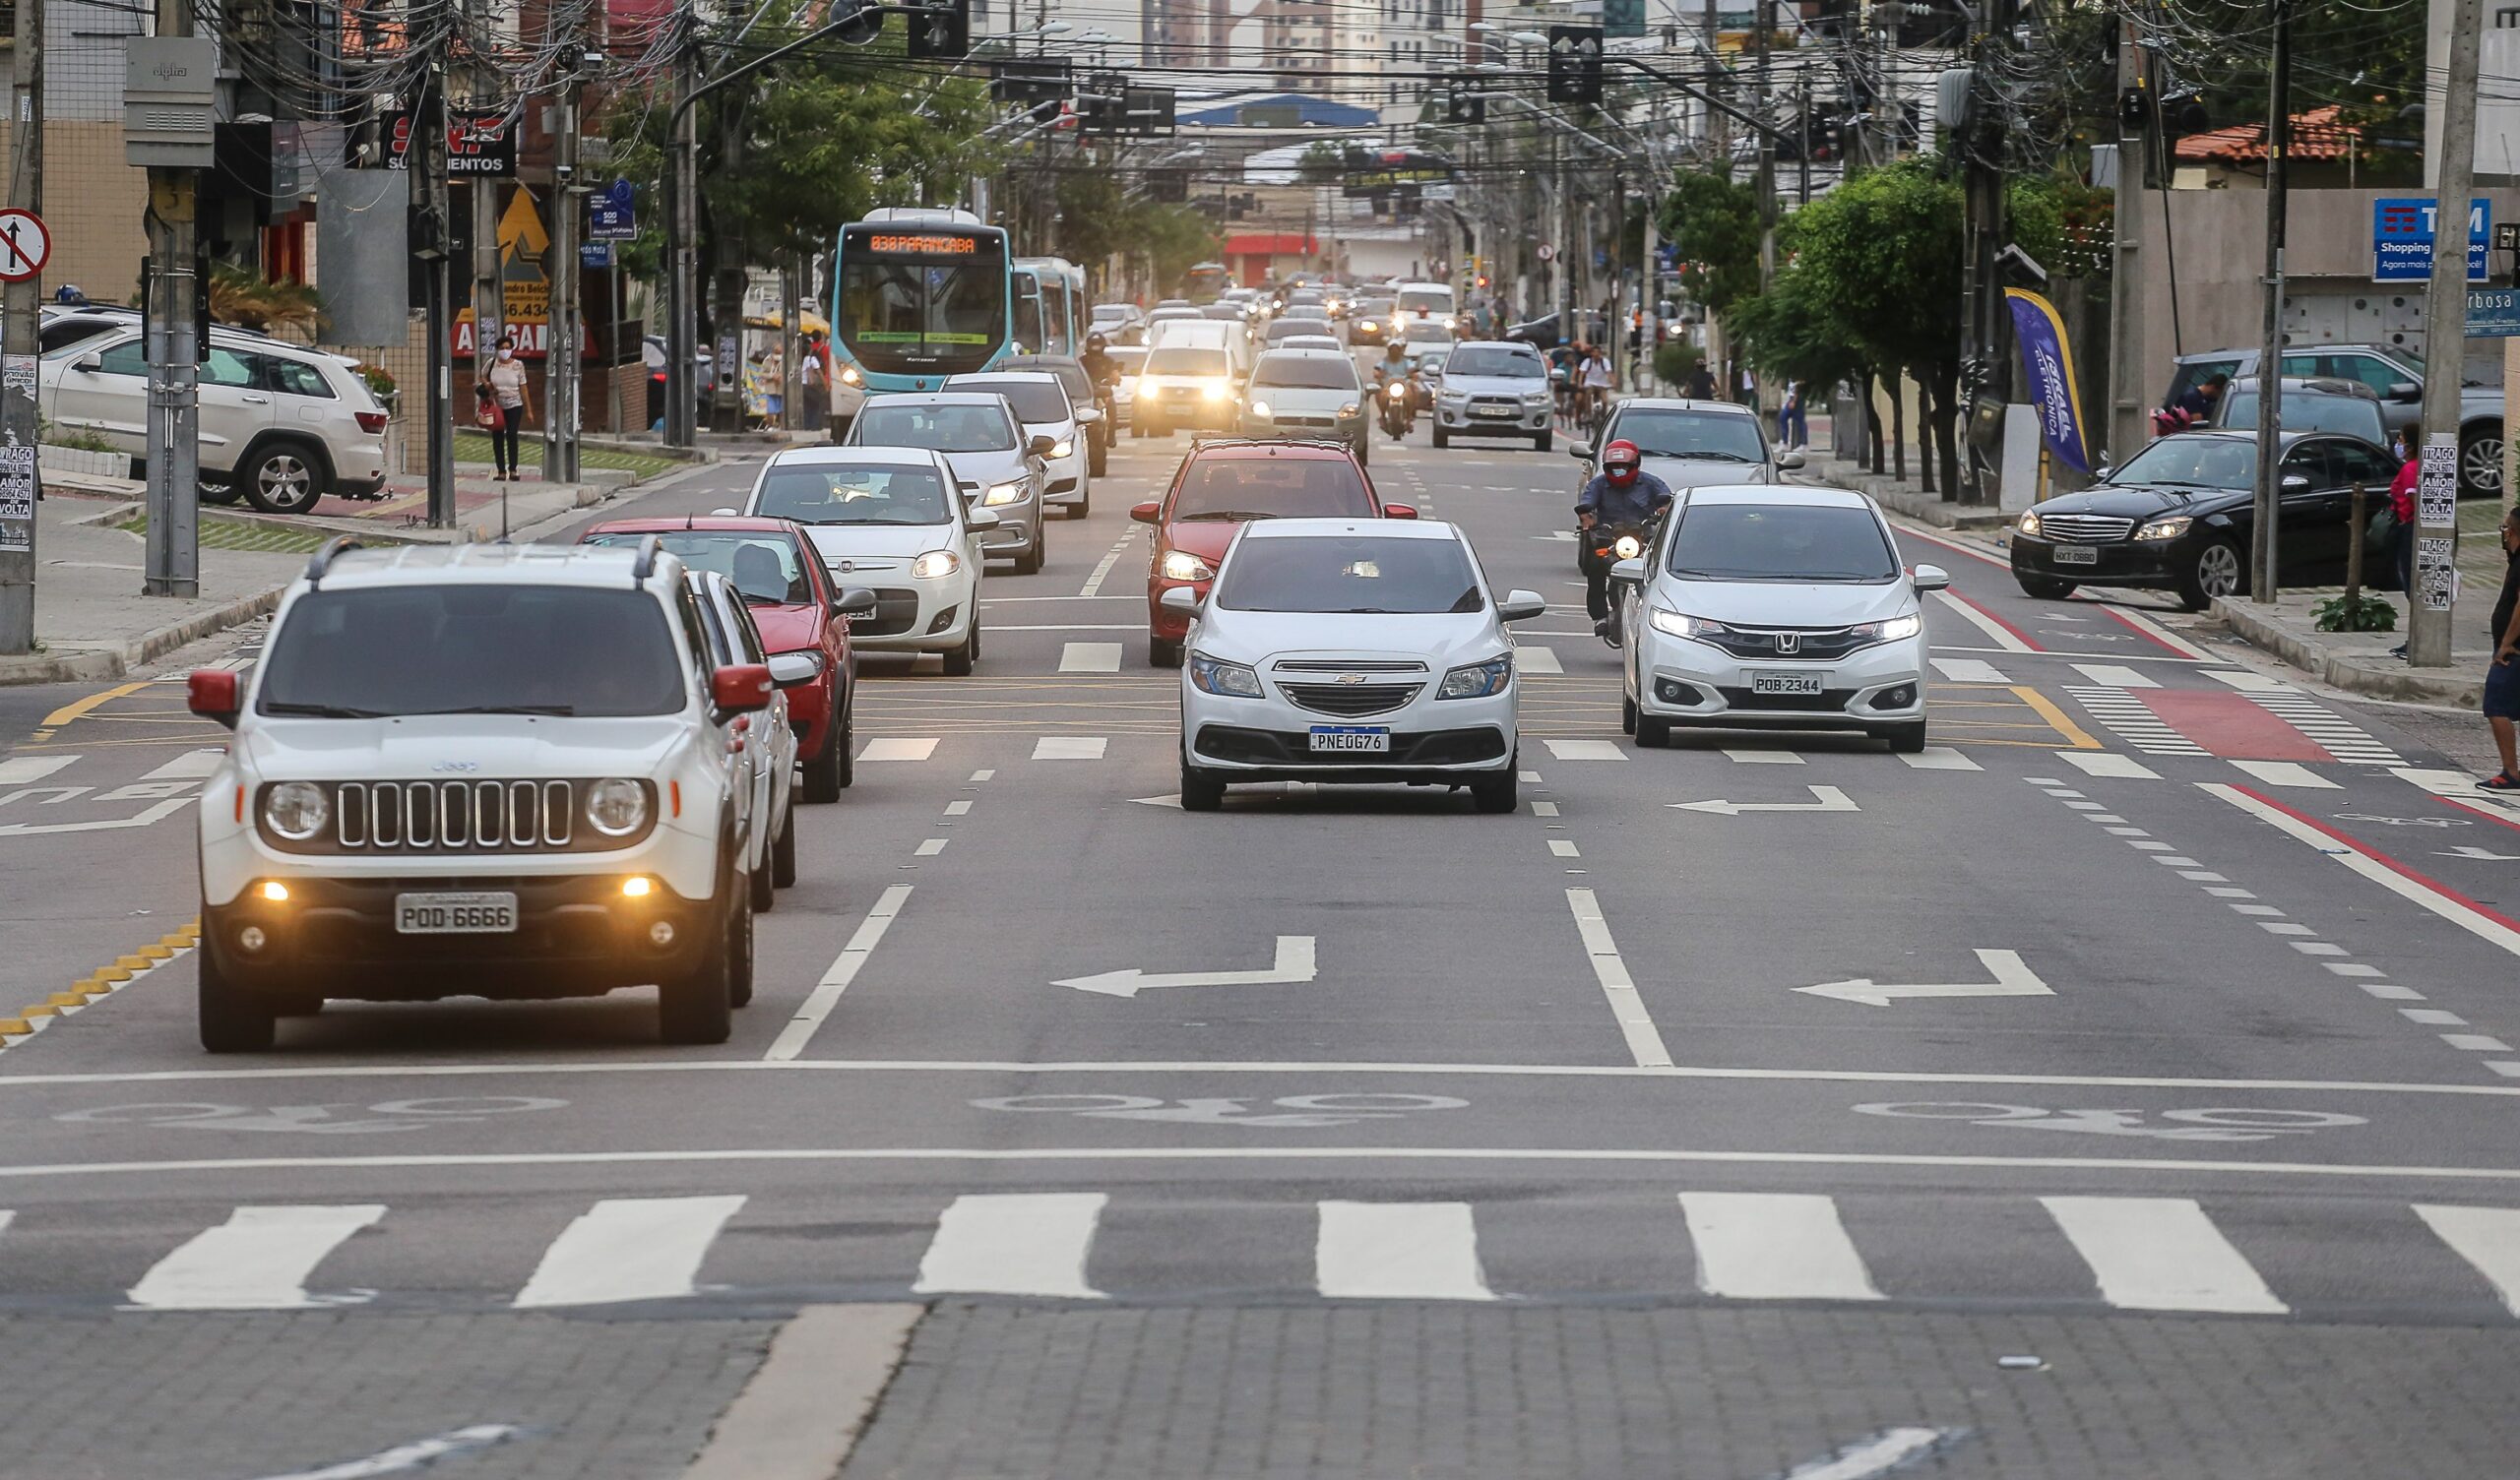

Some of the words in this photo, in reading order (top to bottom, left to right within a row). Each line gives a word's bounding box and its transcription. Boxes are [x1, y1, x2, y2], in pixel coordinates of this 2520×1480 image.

[389, 157, 503, 170] SUENTOS
[2422, 208, 2483, 232] TM
[898, 237, 975, 253] PARANGABA
[2380, 242, 2431, 254] Shopping
[2382, 260, 2406, 270] Agora
[2407, 260, 2426, 269] mais
[2467, 259, 2483, 269] ocê!
[2468, 292, 2512, 309] rbosa
[2424, 448, 2455, 460] TRAGO
[1, 478, 31, 488] AMOR
[2424, 478, 2454, 487] AMOR
[0, 504, 30, 515] VOLTA
[2422, 503, 2453, 514] VOLTA
